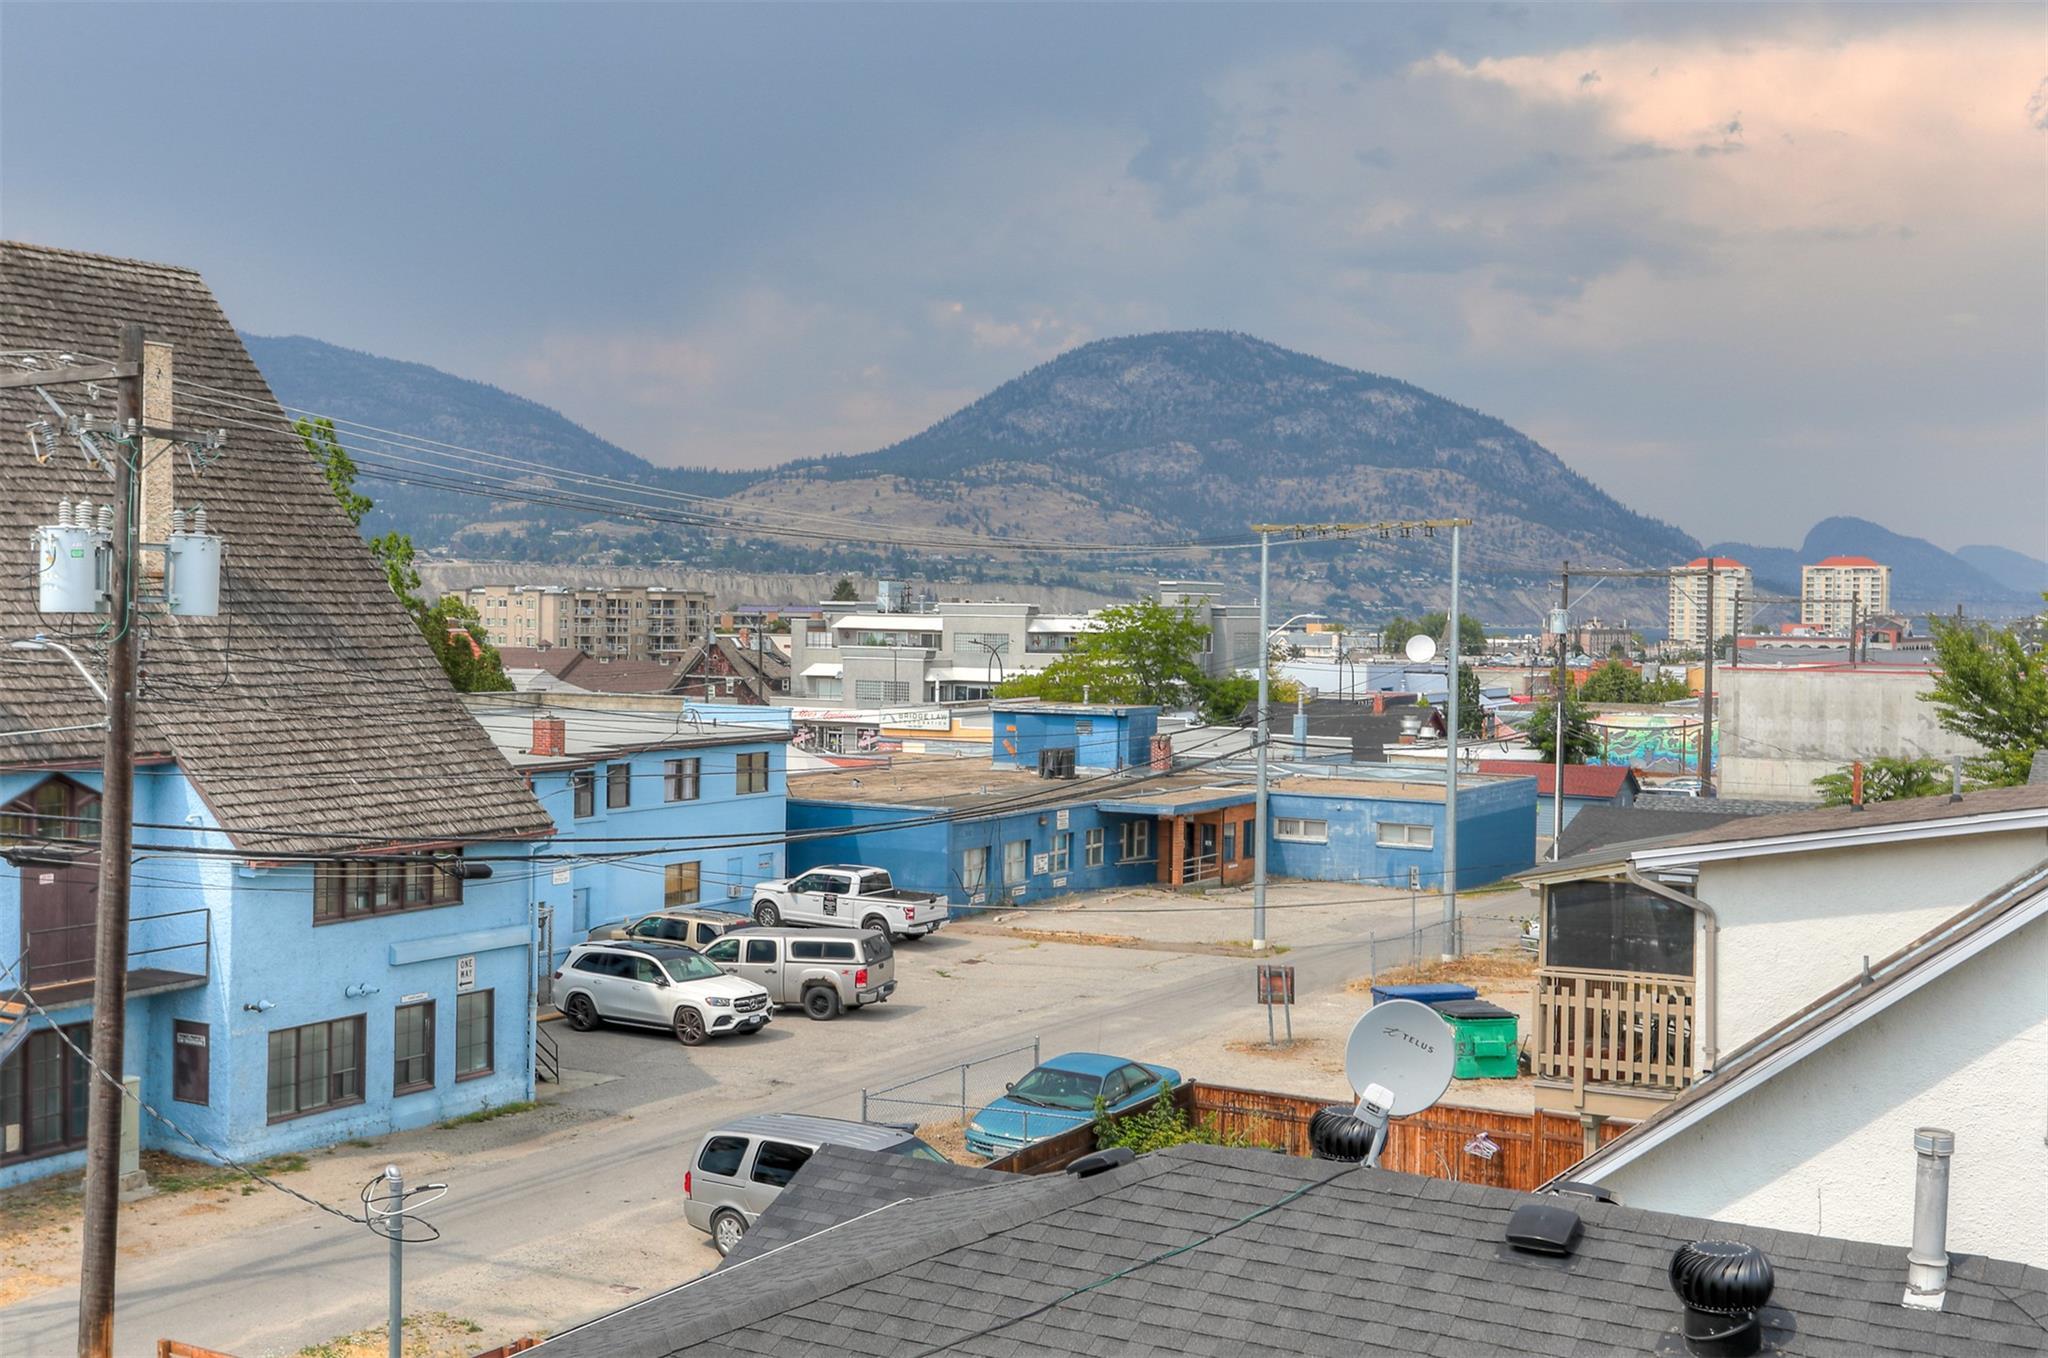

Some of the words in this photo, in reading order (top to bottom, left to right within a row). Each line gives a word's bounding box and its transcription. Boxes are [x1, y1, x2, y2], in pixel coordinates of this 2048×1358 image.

[898, 712, 929, 720] BRIDGE
[931, 712, 947, 720] LAW
[460, 959, 473, 969] ONE
[460, 969, 473, 978] WAY
[1403, 1033, 1435, 1054] TELUS
